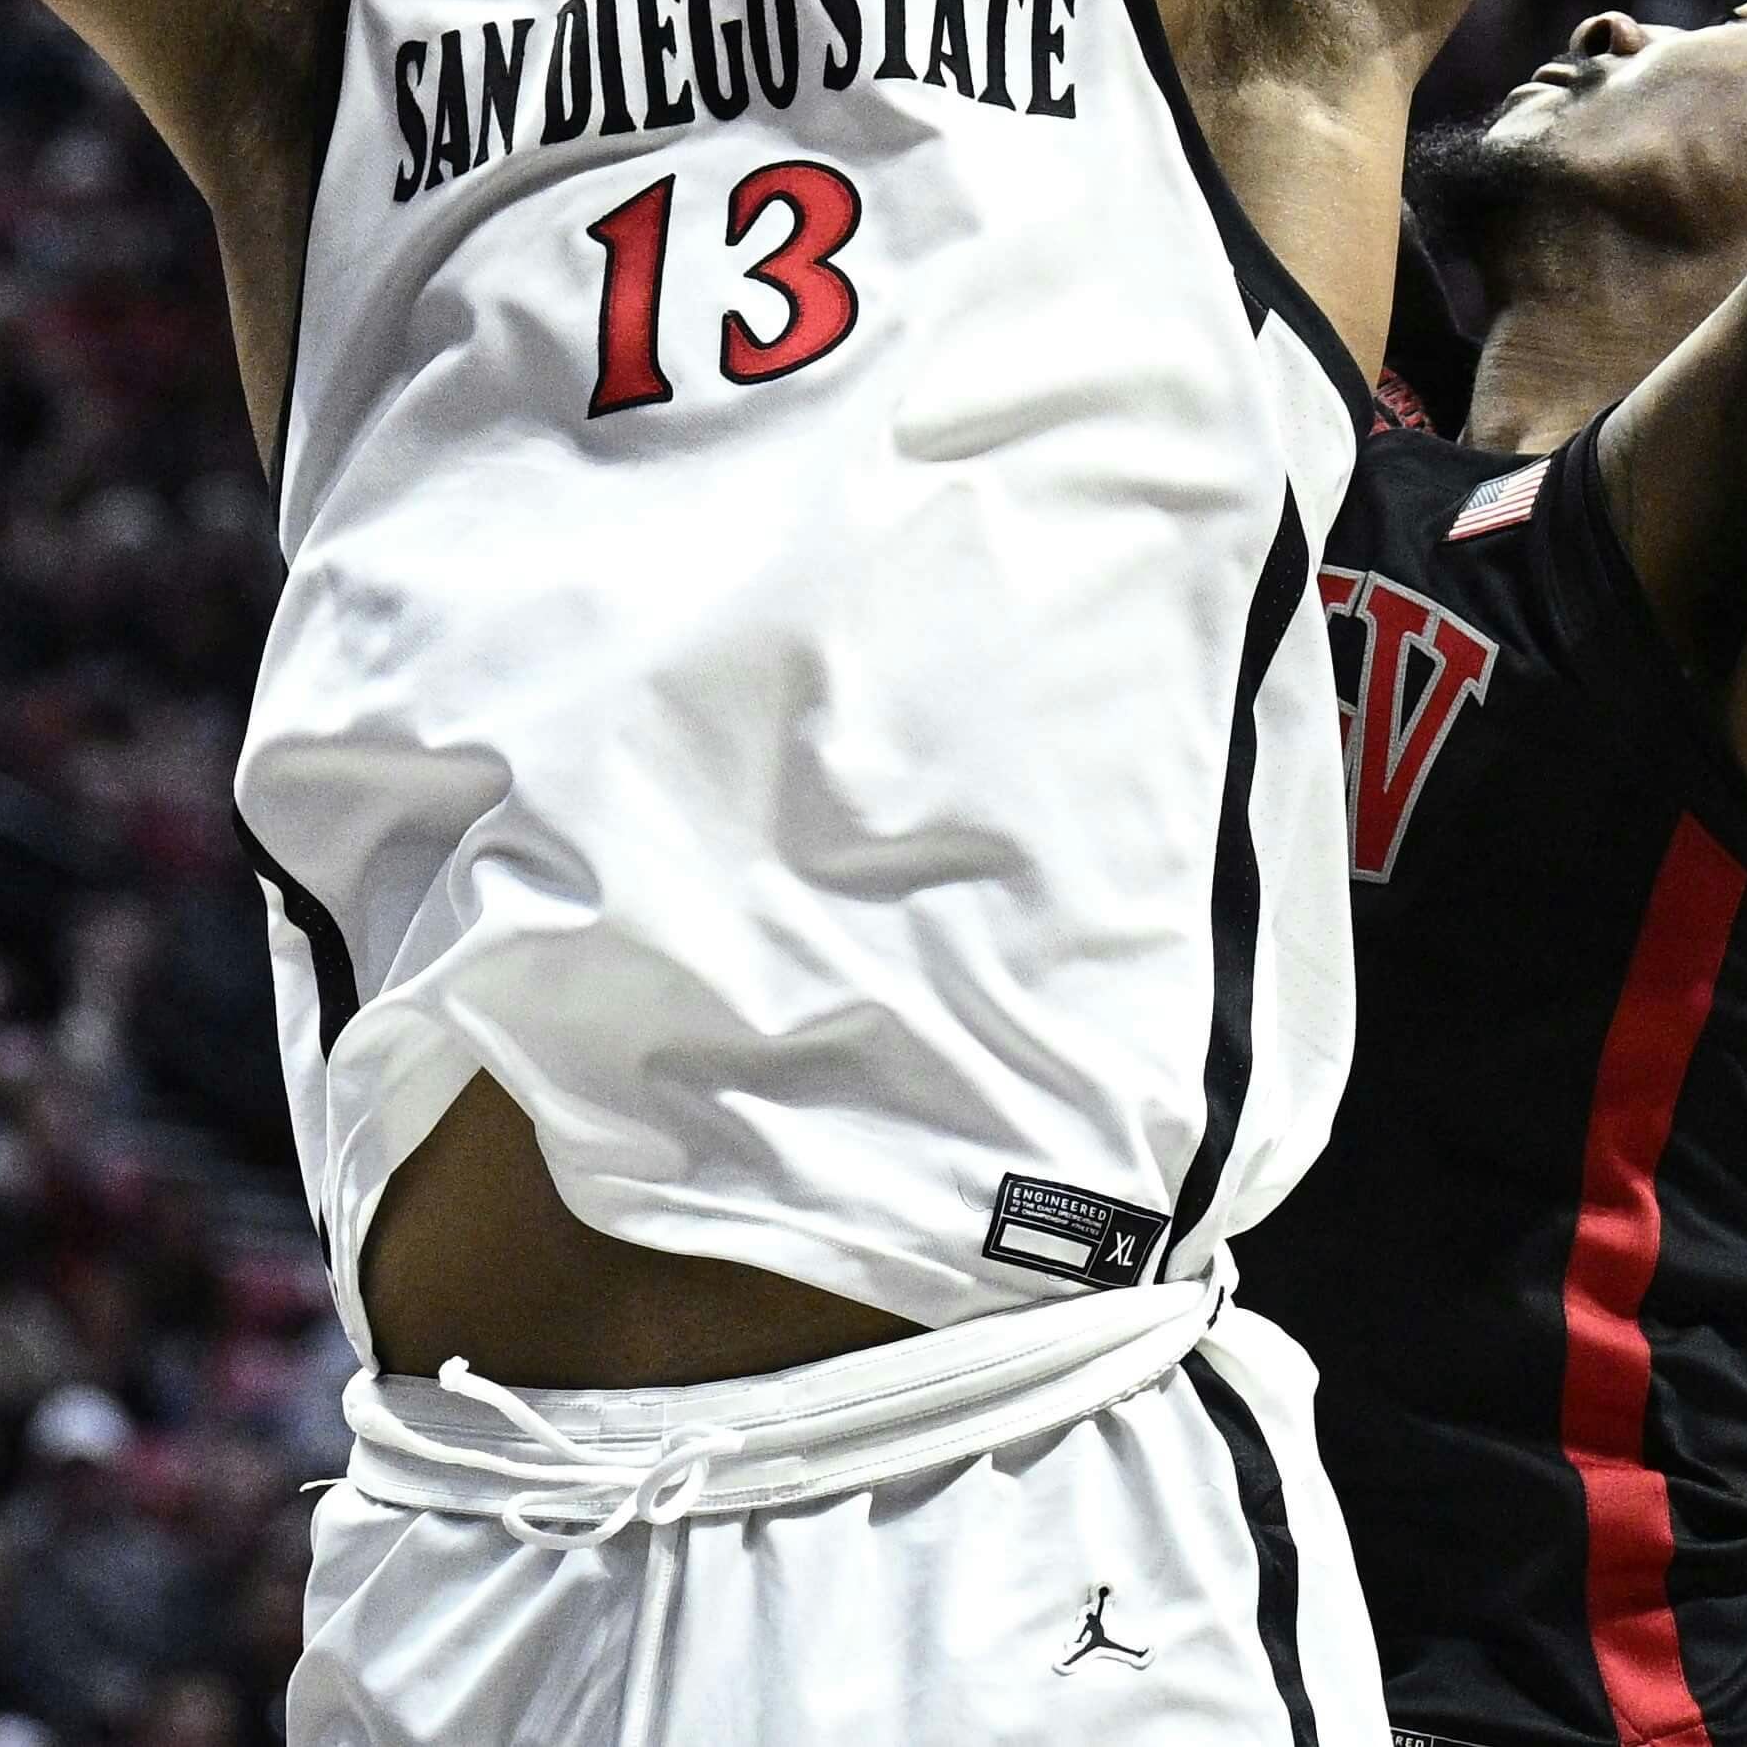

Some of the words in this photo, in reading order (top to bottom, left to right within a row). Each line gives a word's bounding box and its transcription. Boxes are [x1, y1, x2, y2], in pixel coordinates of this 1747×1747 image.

[393, 18, 536, 203] SAN
[586, 159, 864, 420] 13
[1013, 1187, 1107, 1221] ENGINEERED
[1105, 1231, 1136, 1267] XL
